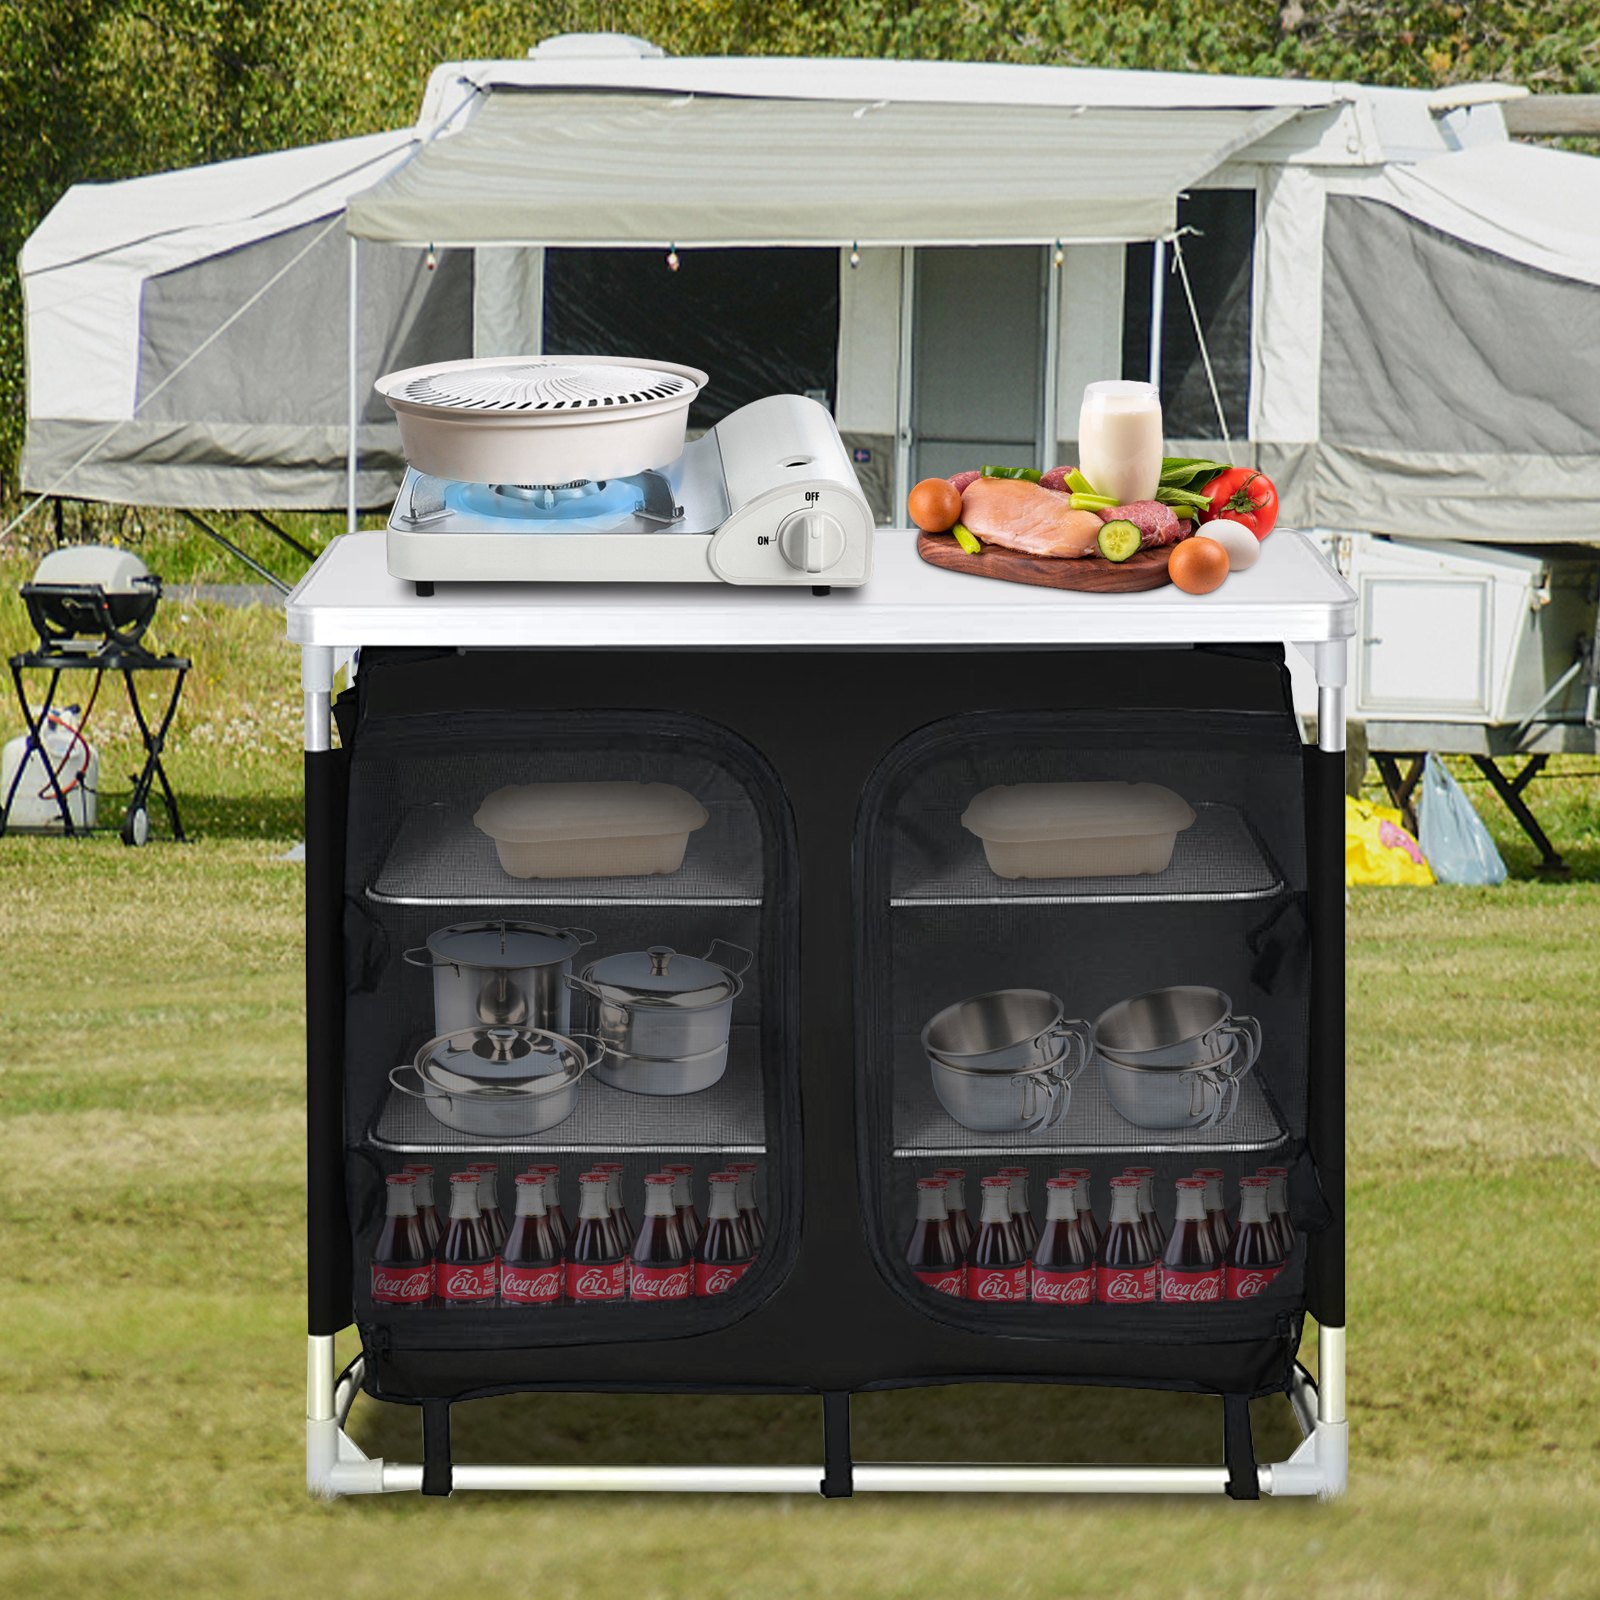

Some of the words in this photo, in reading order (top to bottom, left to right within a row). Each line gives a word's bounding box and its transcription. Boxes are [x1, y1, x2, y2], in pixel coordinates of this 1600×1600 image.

[805, 491, 820, 501] OFF
[757, 535, 769, 545] ON
[373, 1272, 430, 1297] Coca-Cola
[503, 1272, 560, 1297] Coca-Cola
[633, 1272, 689, 1297] Coca-Cola
[1034, 1276, 1090, 1301] Coca-Cola
[1163, 1276, 1220, 1301] Coca-Cola
